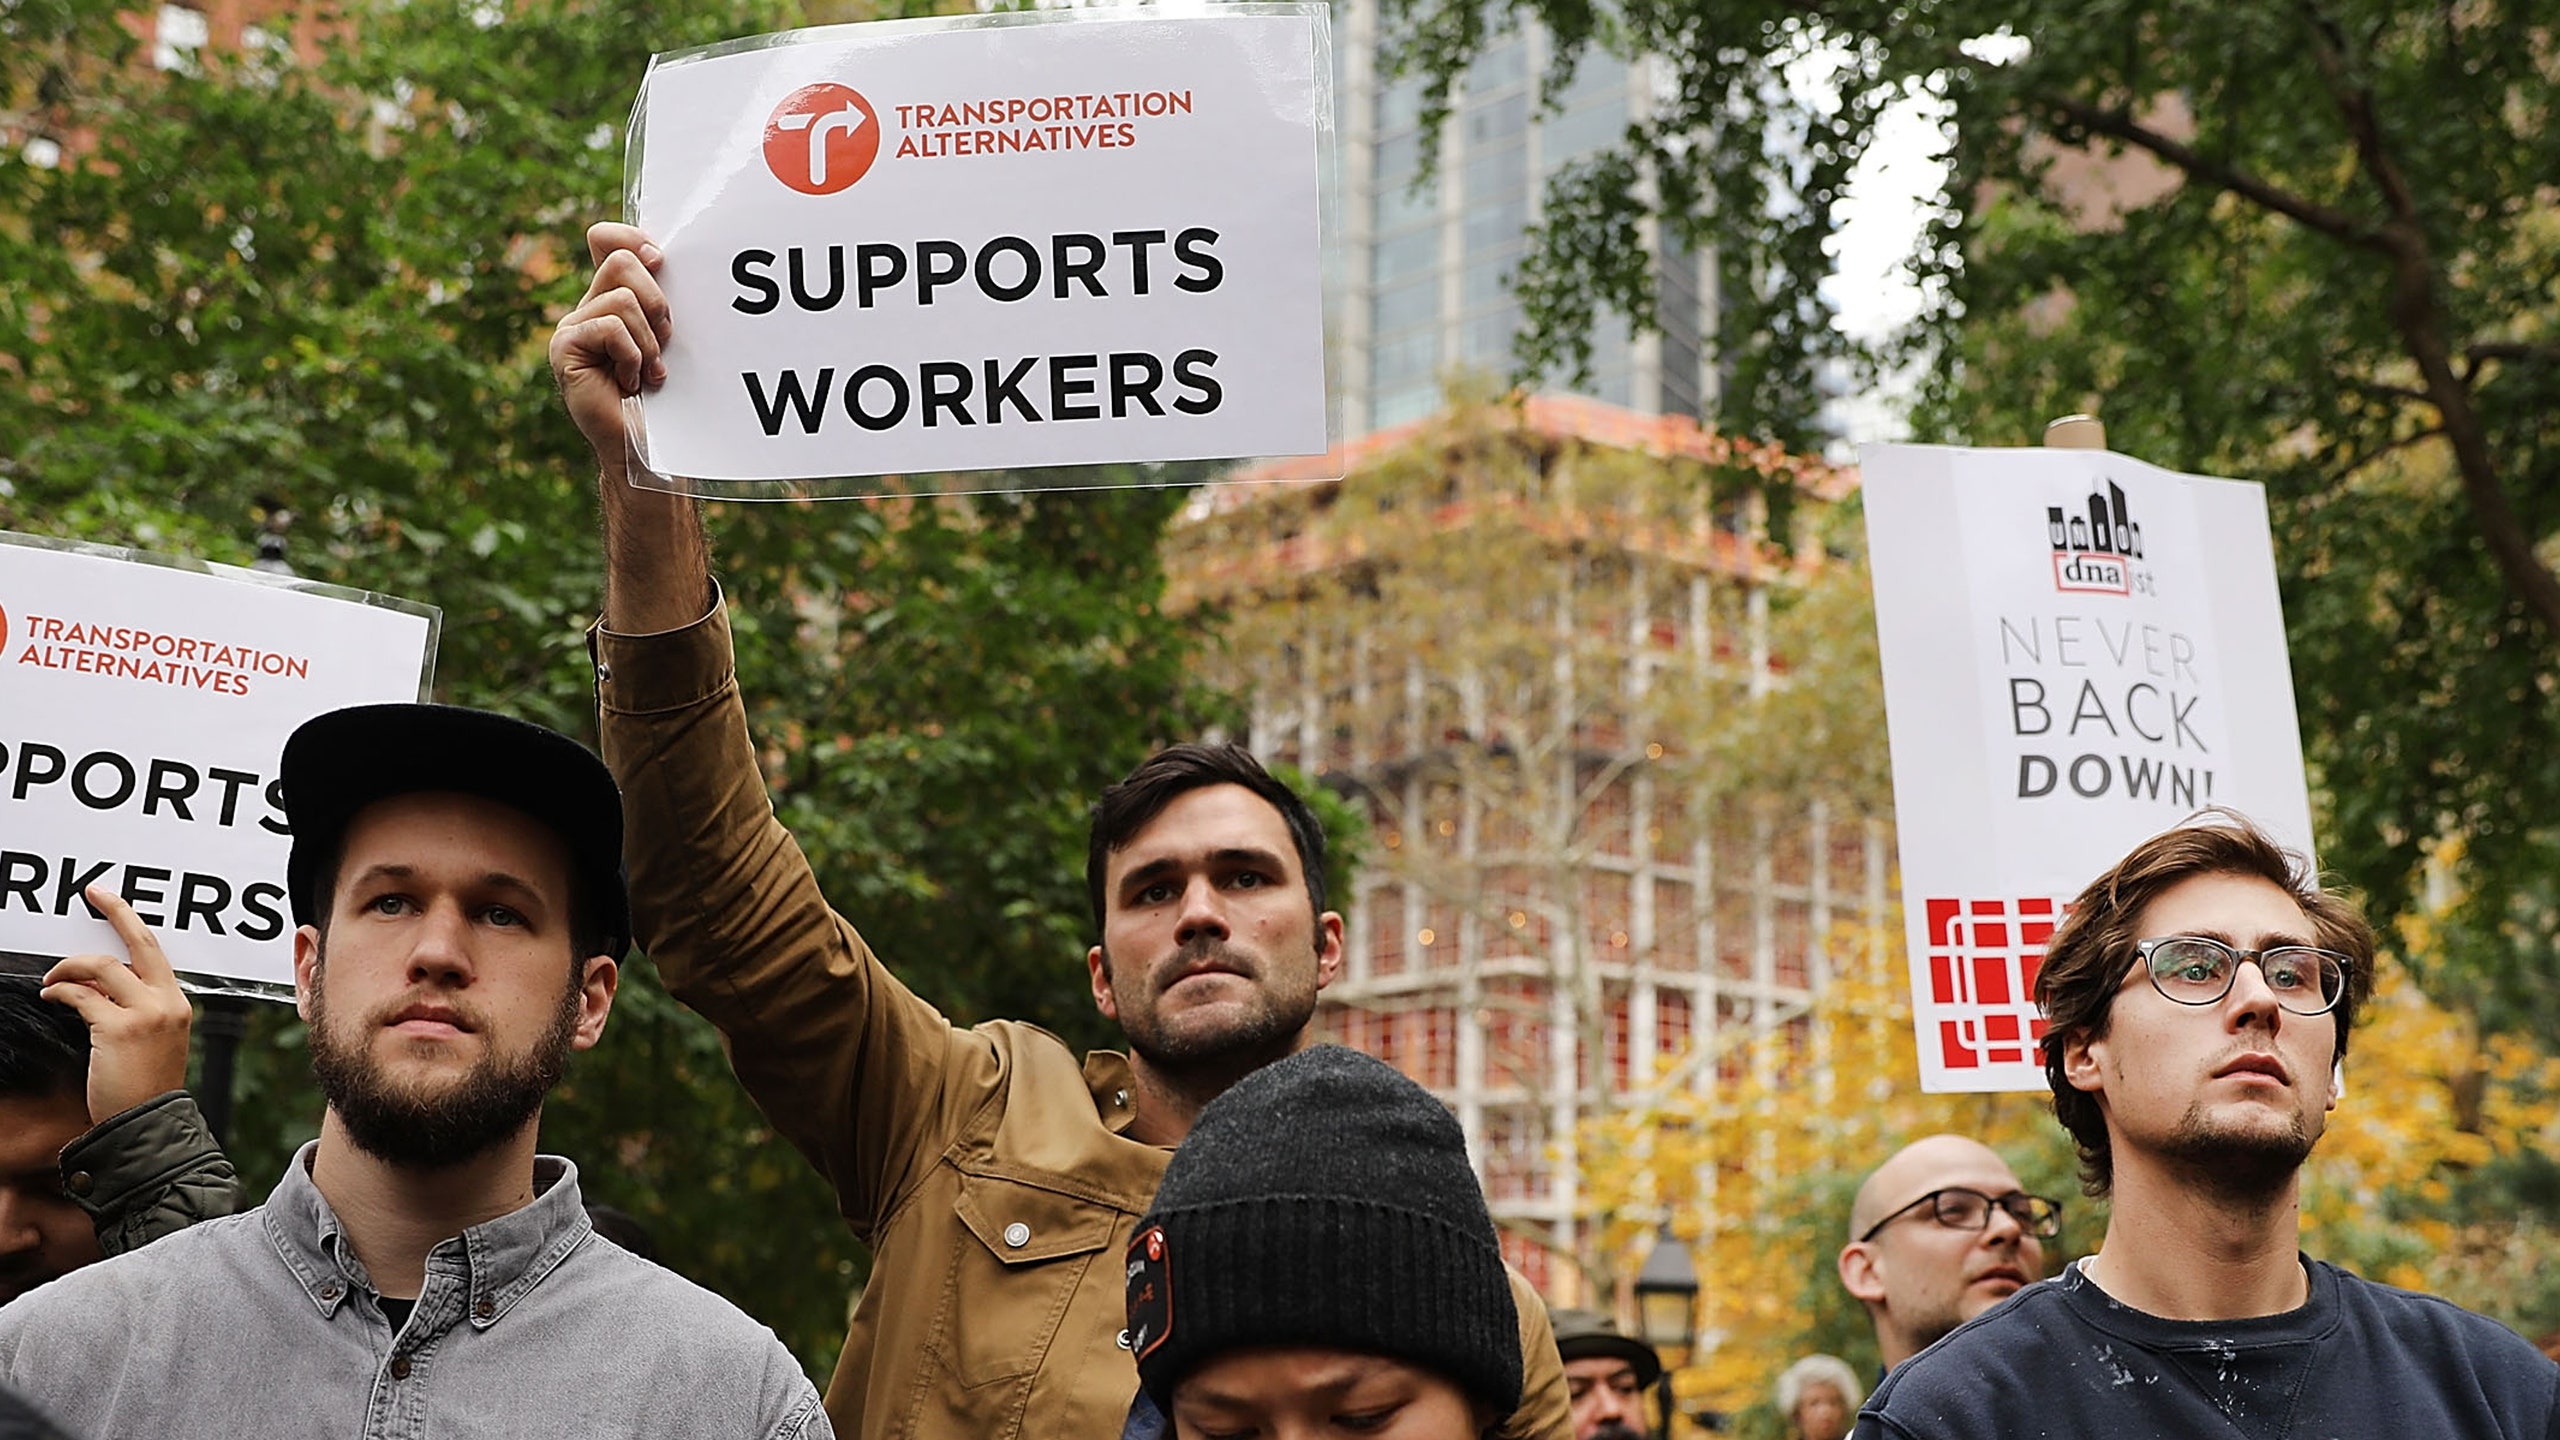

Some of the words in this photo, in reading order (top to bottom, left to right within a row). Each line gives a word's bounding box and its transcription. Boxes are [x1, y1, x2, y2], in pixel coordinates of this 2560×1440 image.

[895, 122, 1135, 159] ALTERNATIVES
[896, 90, 1192, 131] TRANSPORTATION
[731, 228, 1224, 314] SUPPORTS
[743, 349, 1223, 436] WORKERS
[2065, 555, 2120, 584] dna
[19, 645, 250, 696] ALTERNATIVES
[26, 615, 309, 680] TRANSPORTATION
[2000, 616, 2200, 684] NEVER
[2010, 678, 2209, 753] BACK
[0, 741, 293, 836] PORTS
[2018, 753, 2213, 808] DOWN!
